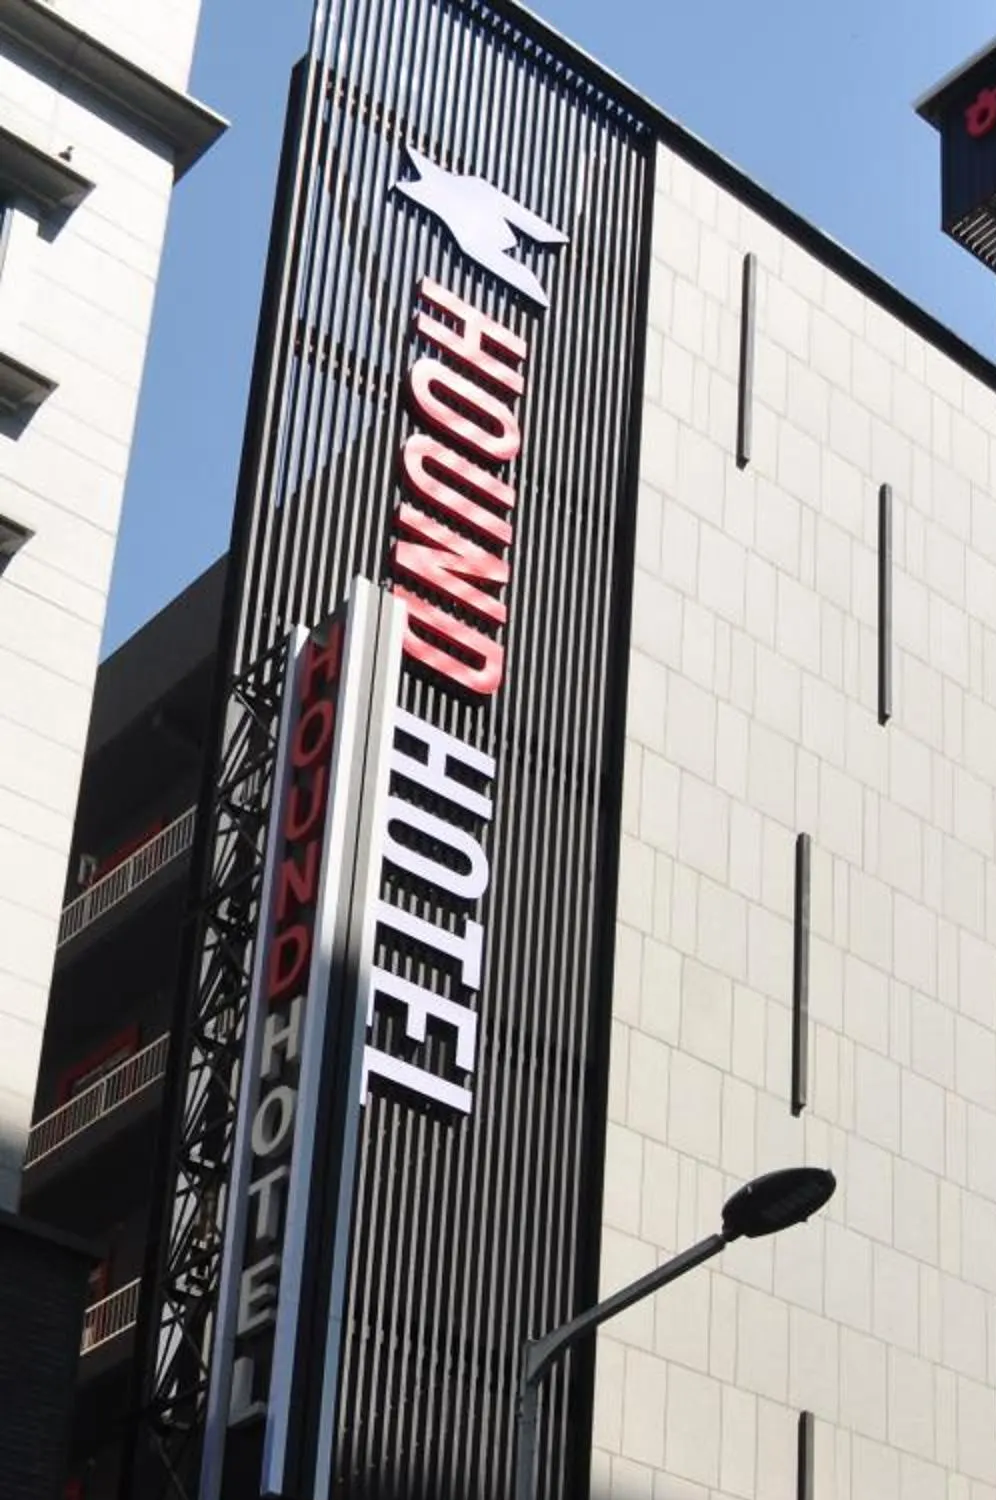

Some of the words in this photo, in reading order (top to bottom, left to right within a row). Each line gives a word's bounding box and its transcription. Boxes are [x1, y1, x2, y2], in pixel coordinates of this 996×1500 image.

[392, 277, 528, 695] HOUND
[268, 620, 344, 1000] HOUND
[360, 705, 497, 1114] HOTEL
[228, 996, 301, 1428] HOTEL
